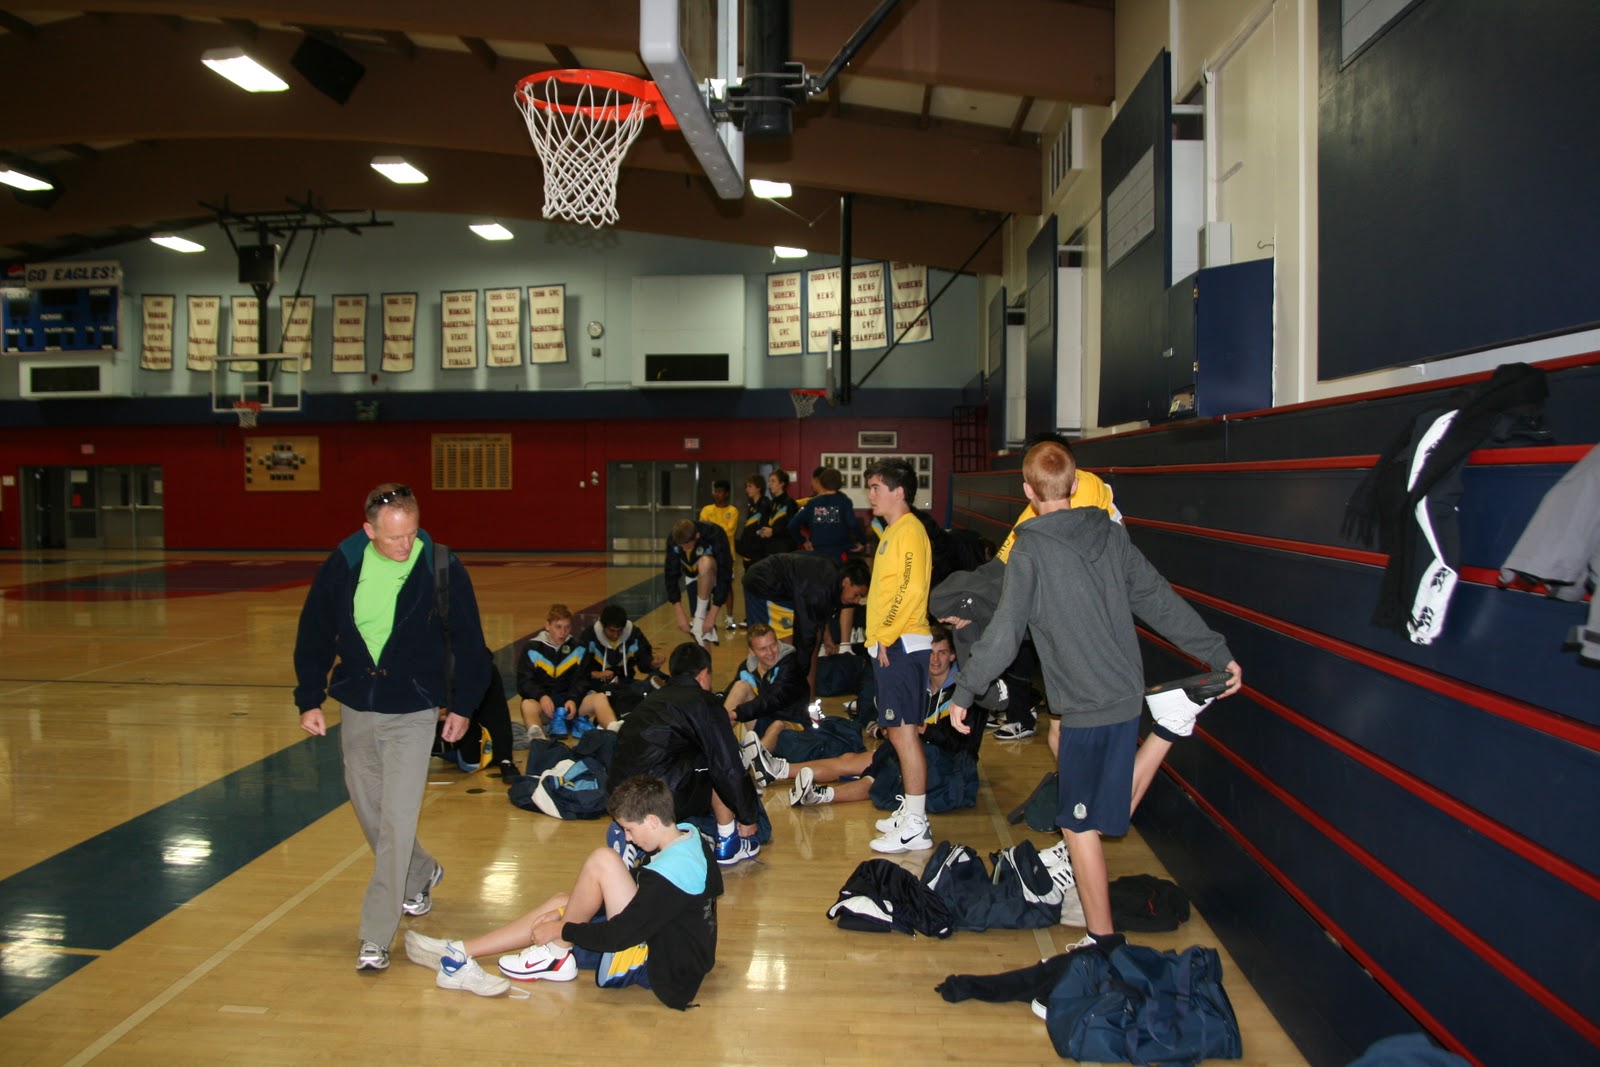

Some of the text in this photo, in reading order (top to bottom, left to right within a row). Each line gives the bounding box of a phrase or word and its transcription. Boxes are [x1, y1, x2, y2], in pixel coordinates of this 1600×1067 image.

[28, 267, 117, 282] GO EAGLES!
[857, 283, 875, 291] MENS
[897, 280, 923, 290] WOMENS
[773, 291, 796, 299] WOMENS
[816, 291, 834, 300] MENS
[850, 295, 885, 304] BASKETBALL
[893, 298, 928, 309] BASKETBALL
[492, 305, 515, 313] WOMENS
[536, 307, 559, 315] WOMENS
[768, 303, 801, 311] BASKETBALL
[448, 308, 471, 316] WOMENS
[808, 309, 842, 318] BASKETBALL
[442, 320, 475, 328] BASKETBALL
[487, 317, 519, 326] BASKETBALL
[531, 324, 565, 332] BASKETBALL
[851, 332, 886, 342] CHAMPIONS
[532, 342, 564, 350] CHAMPIONS
[769, 340, 801, 349] CHAMPIONS
[446, 345, 472, 353] QUARTER
[448, 358, 471, 366] FINALS
